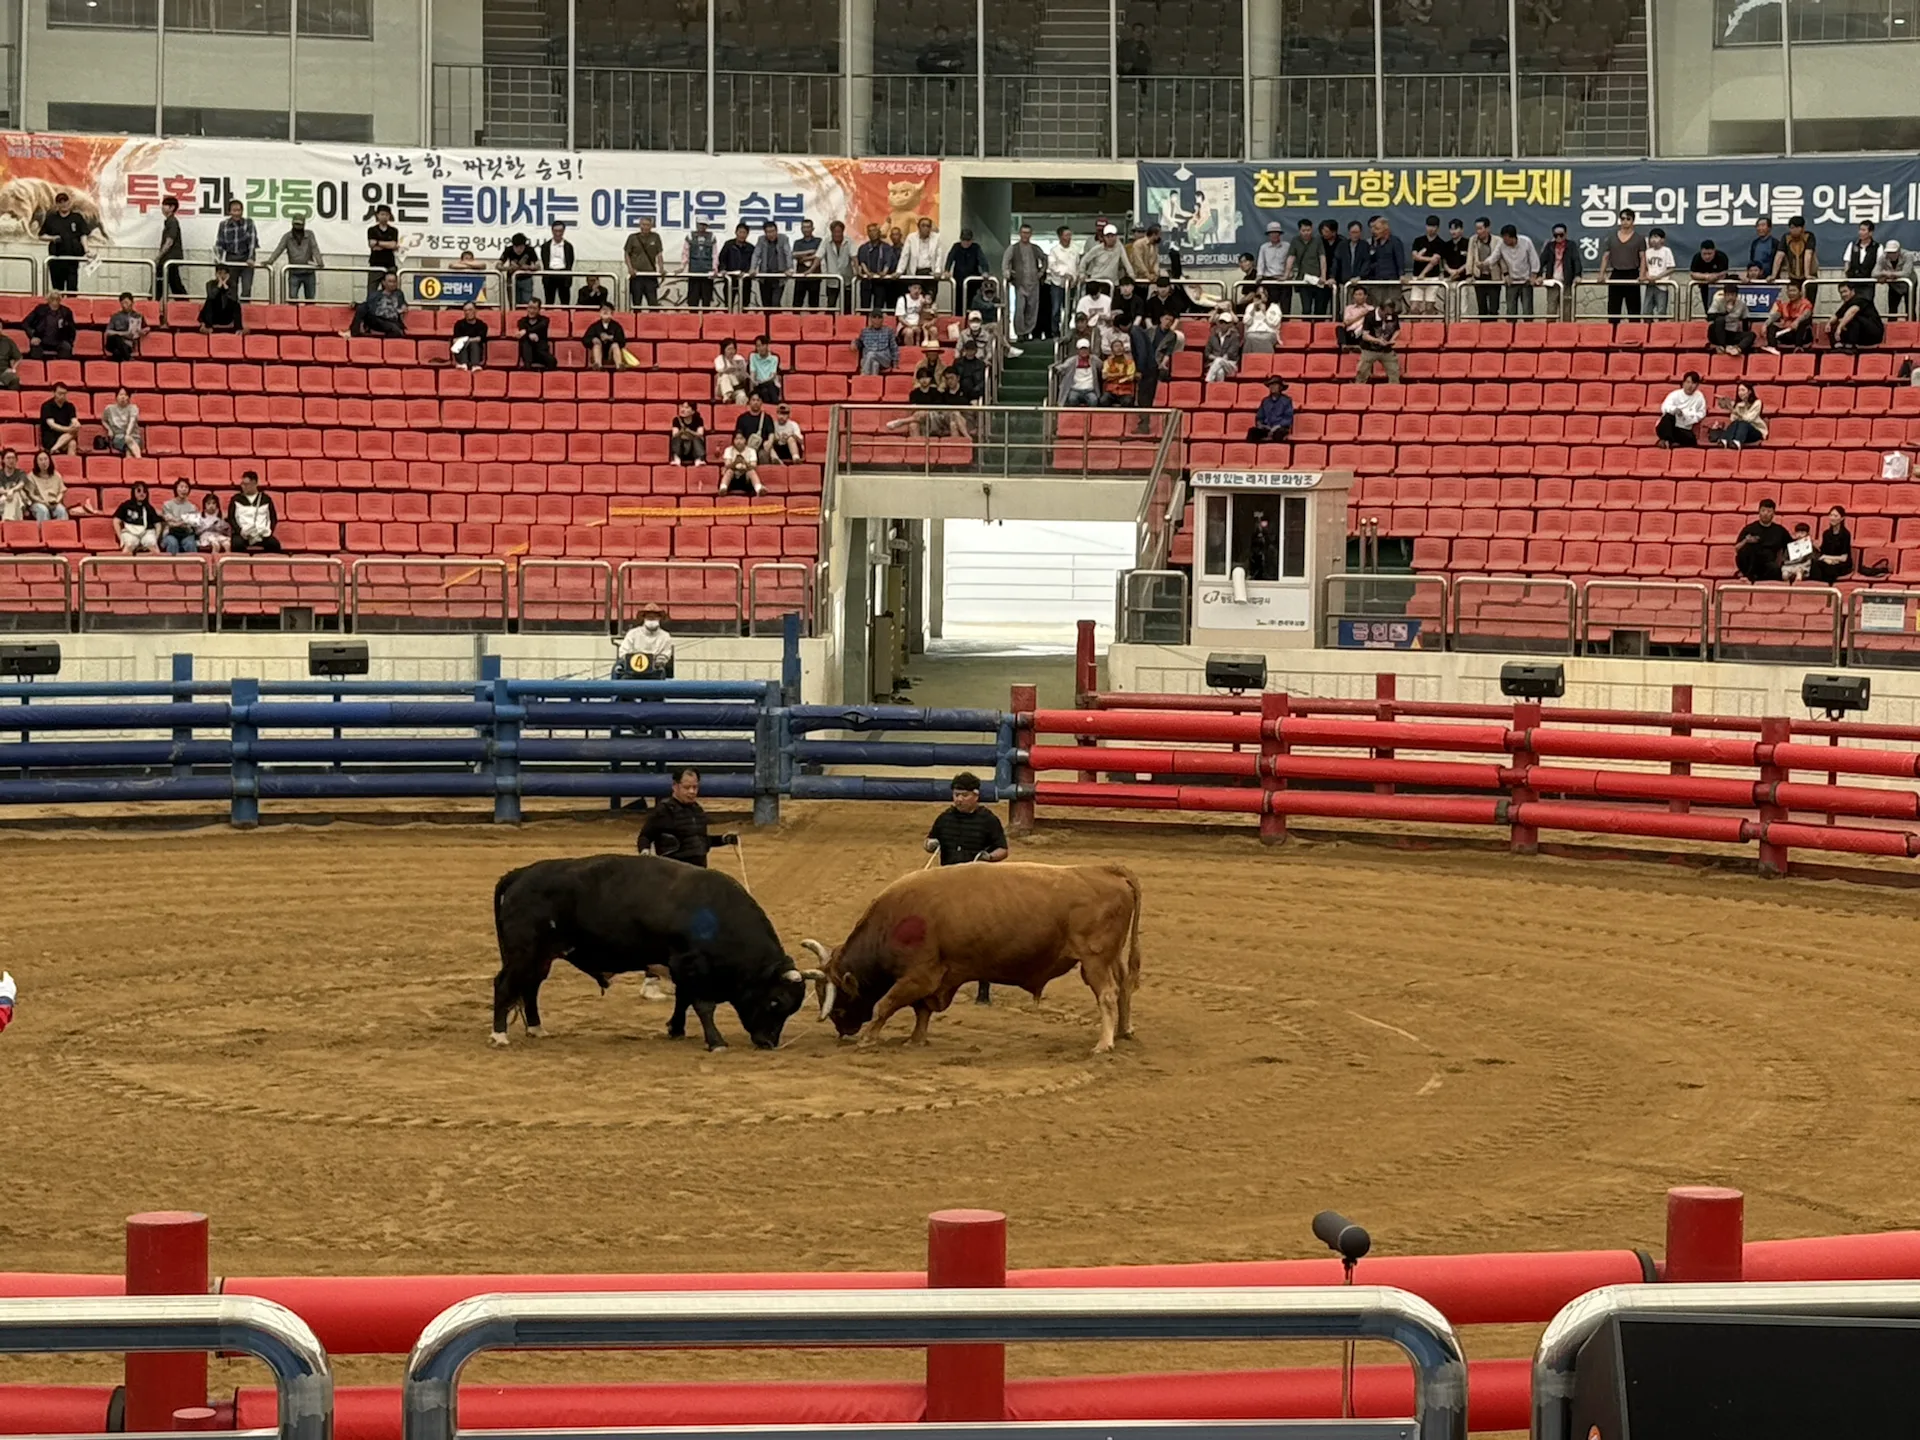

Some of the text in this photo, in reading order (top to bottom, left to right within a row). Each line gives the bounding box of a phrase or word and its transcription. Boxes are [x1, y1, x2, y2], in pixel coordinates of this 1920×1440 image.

[353, 153, 413, 177] 넘치는
[463, 155, 526, 181] 짜릿한
[535, 157, 584, 181] 승부!
[127, 174, 805, 229] 투혼과 감동이 있는 돌아서는 아름다운 승부
[1253, 168, 1572, 208] 청도 고향사랑기부제!
[1580, 184, 1689, 228] 청도와
[1696, 183, 1804, 227] 당신을
[424, 279, 474, 297] 6 관람석
[1738, 293, 1770, 307] 람석
[634, 655, 643, 669] 4
